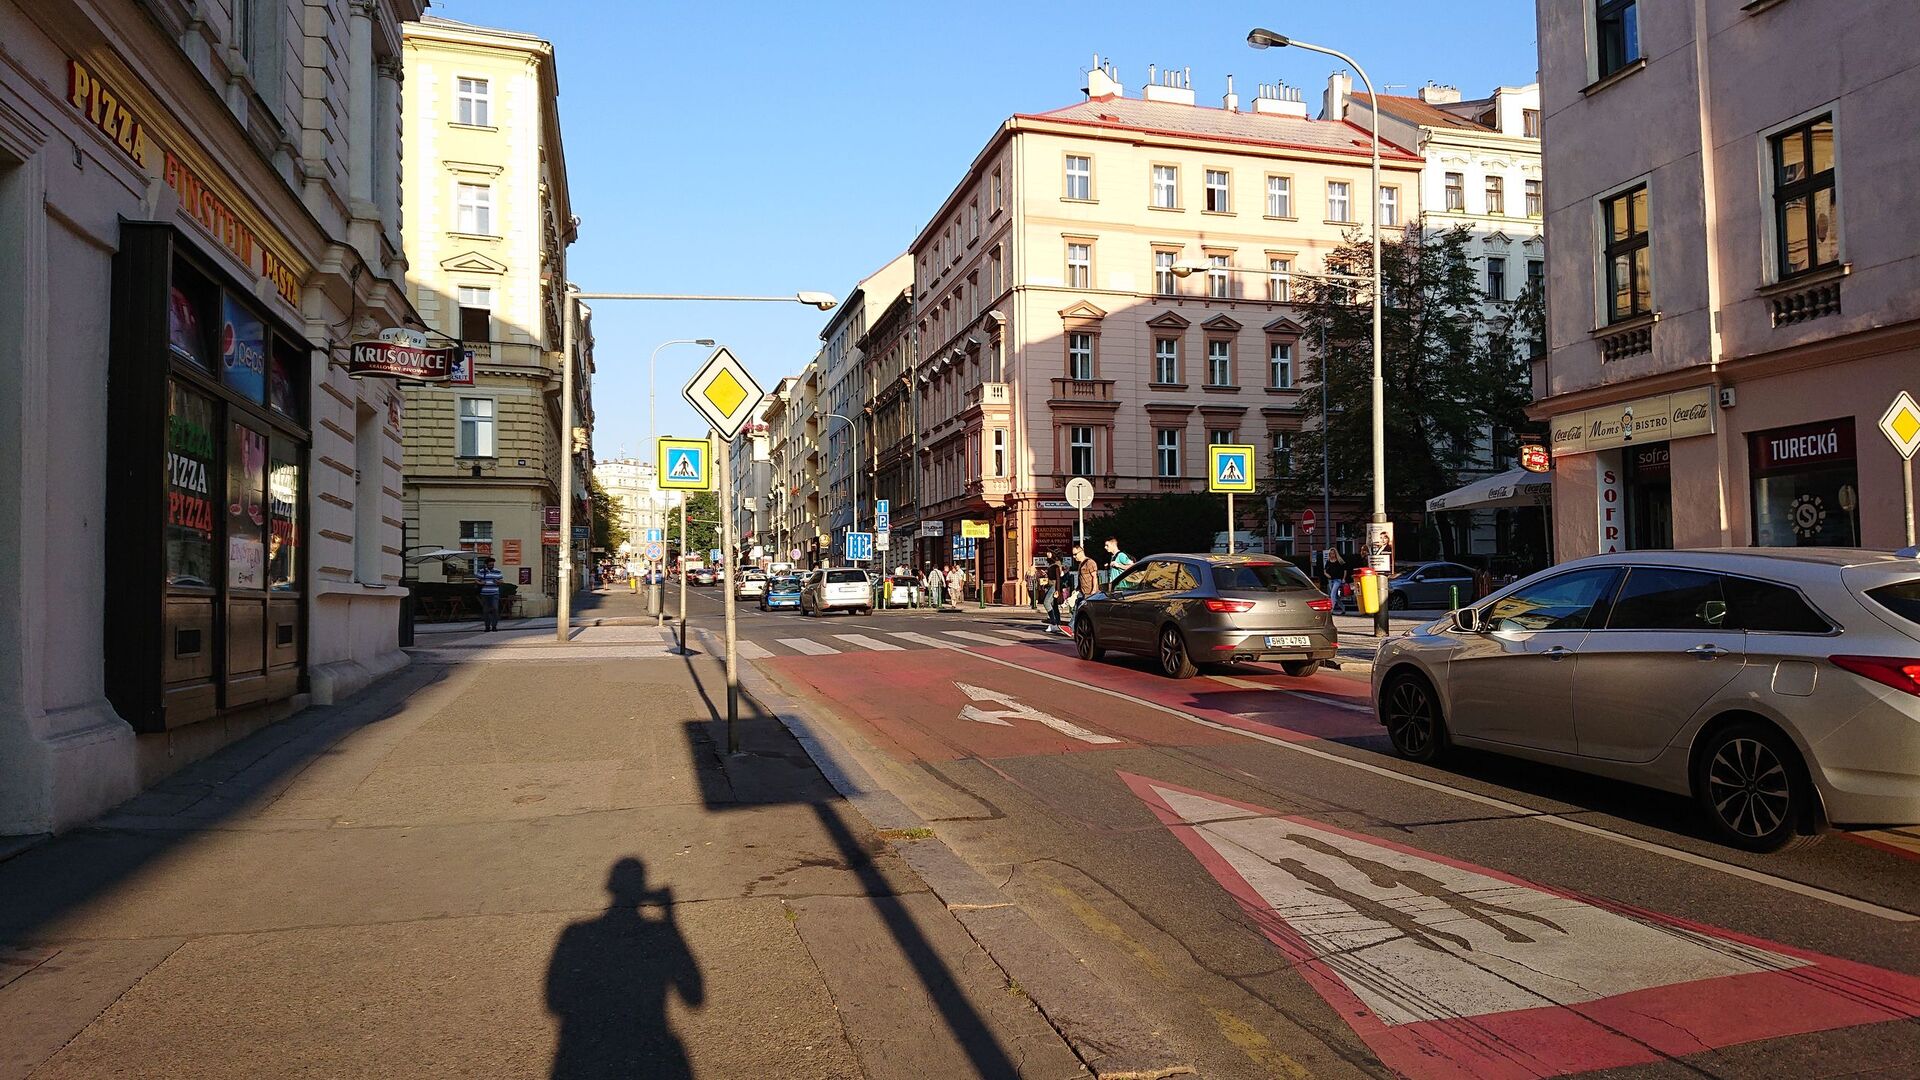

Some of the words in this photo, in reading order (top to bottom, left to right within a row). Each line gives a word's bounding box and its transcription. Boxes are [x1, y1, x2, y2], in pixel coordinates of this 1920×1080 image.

[69, 60, 150, 169] PIZZA
[165, 151, 255, 267] EINSTEIN
[263, 250, 299, 308] PASTA
[354, 345, 445, 369] KRUŠOVICE
[1635, 417, 1668, 431] BISTRO
[1638, 448, 1669, 464] sofra
[1770, 428, 1838, 461] TURECKÁ
[168, 490, 214, 532] PIZZA
